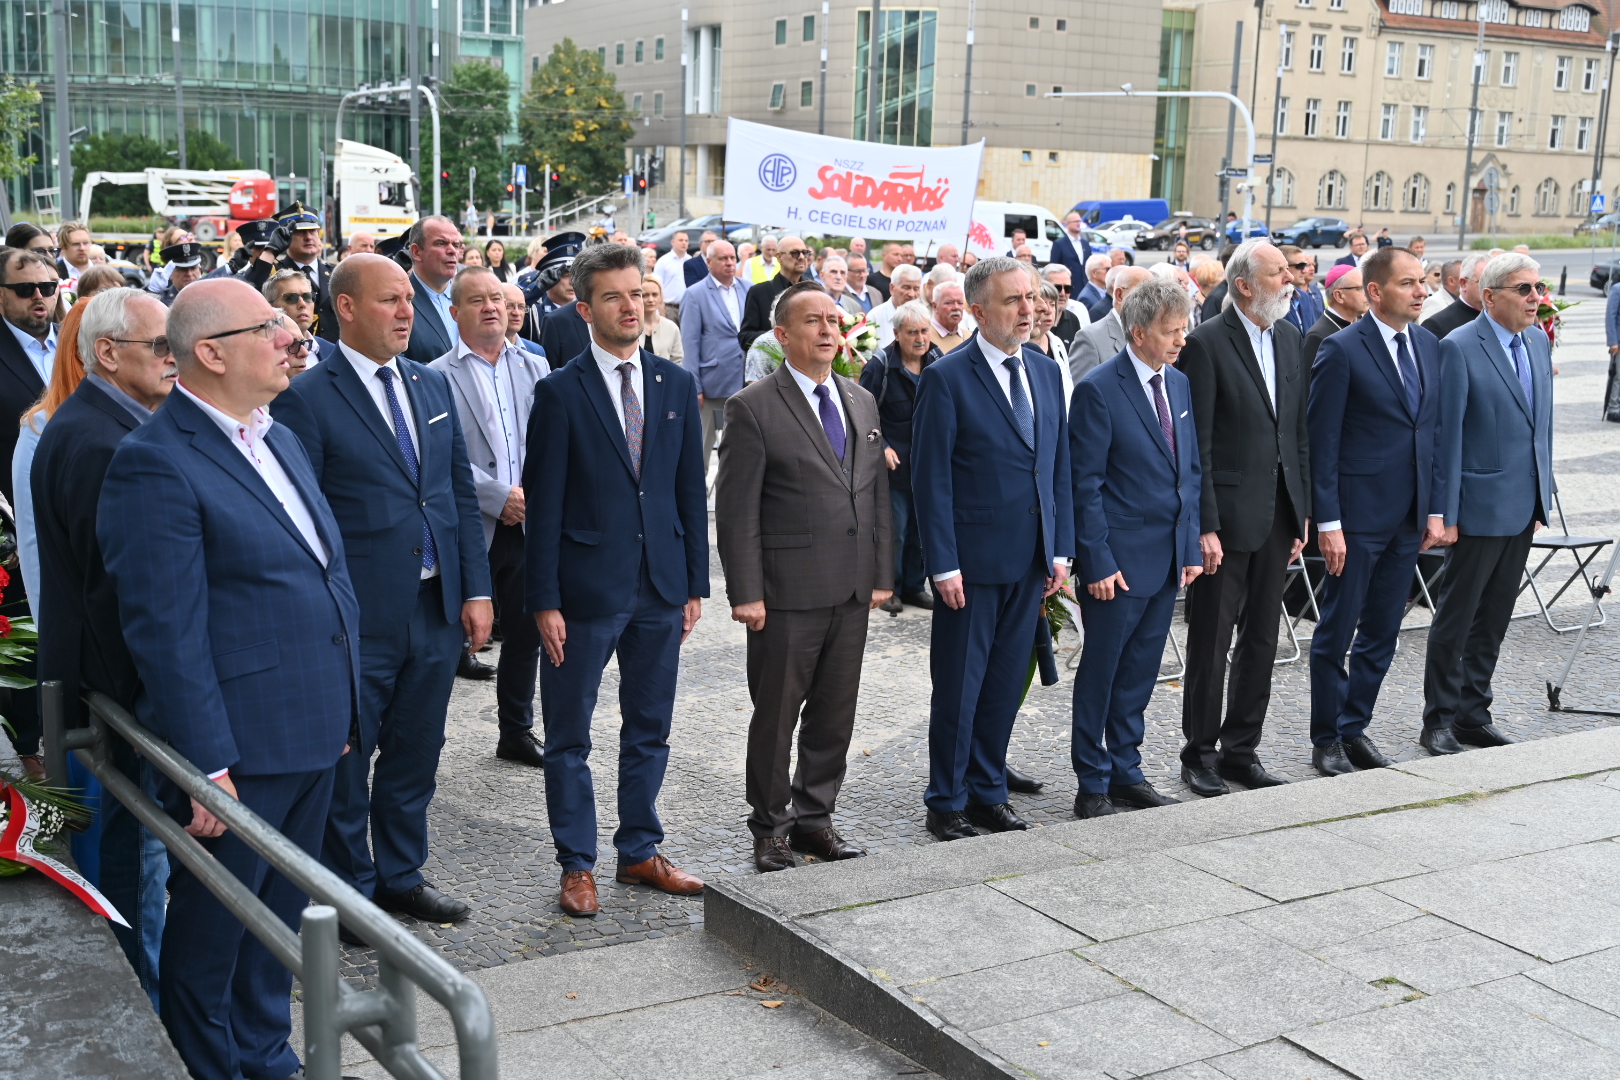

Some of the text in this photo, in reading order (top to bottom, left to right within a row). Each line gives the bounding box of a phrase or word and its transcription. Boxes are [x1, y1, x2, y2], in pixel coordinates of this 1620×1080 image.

[834, 158, 865, 172] NSZZ
[787, 205, 948, 233] H. CEGIELSKI POZNAŃ
